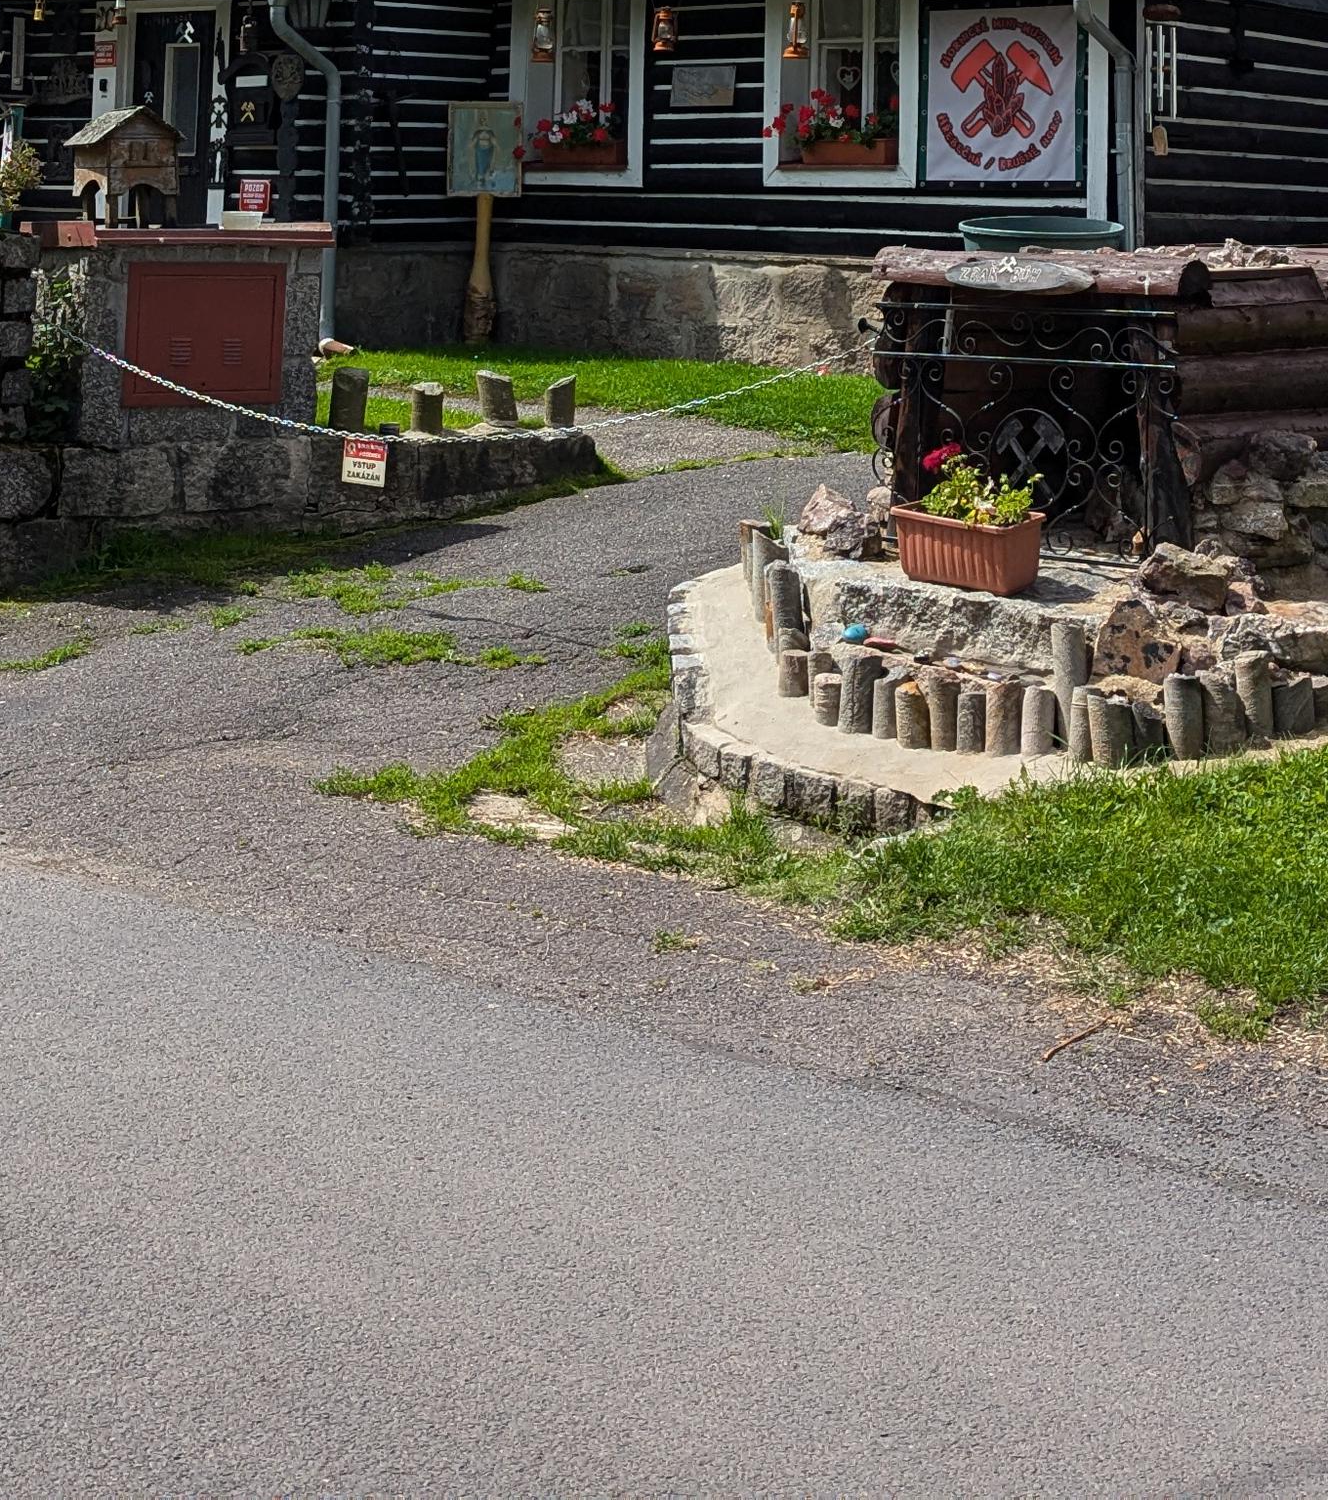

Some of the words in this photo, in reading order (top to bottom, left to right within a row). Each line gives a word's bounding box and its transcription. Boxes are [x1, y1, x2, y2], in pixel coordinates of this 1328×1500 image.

[940, 16, 990, 69] HORNICKÉ
[1040, 110, 1063, 149] HORY
[346, 470, 381, 481] ZAKÁZÁN
[352, 461, 376, 470] VSTUP
